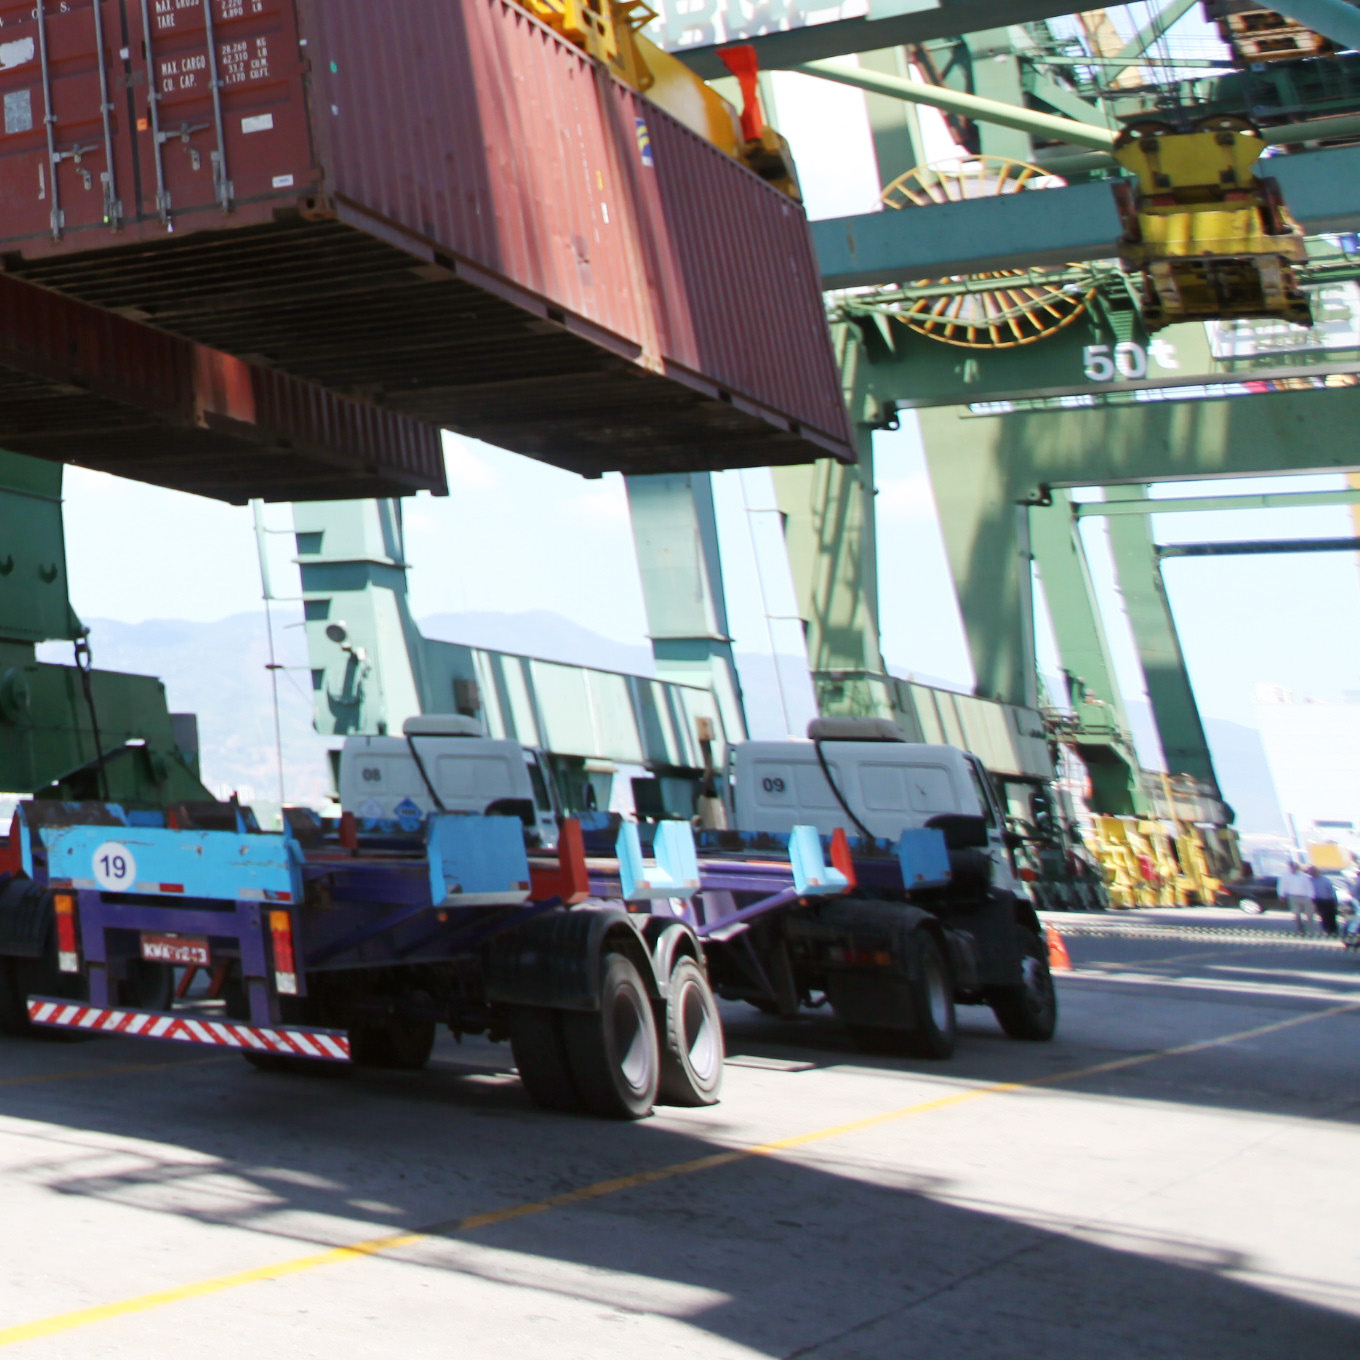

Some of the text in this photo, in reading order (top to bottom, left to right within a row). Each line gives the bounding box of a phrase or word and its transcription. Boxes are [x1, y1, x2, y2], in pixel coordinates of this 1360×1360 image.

[157, 13, 175, 29] TARE
[181, 55, 206, 72] CARGO
[1083, 338, 1179, 382] 50t
[762, 777, 785, 792] 09
[100, 854, 127, 879] 19
